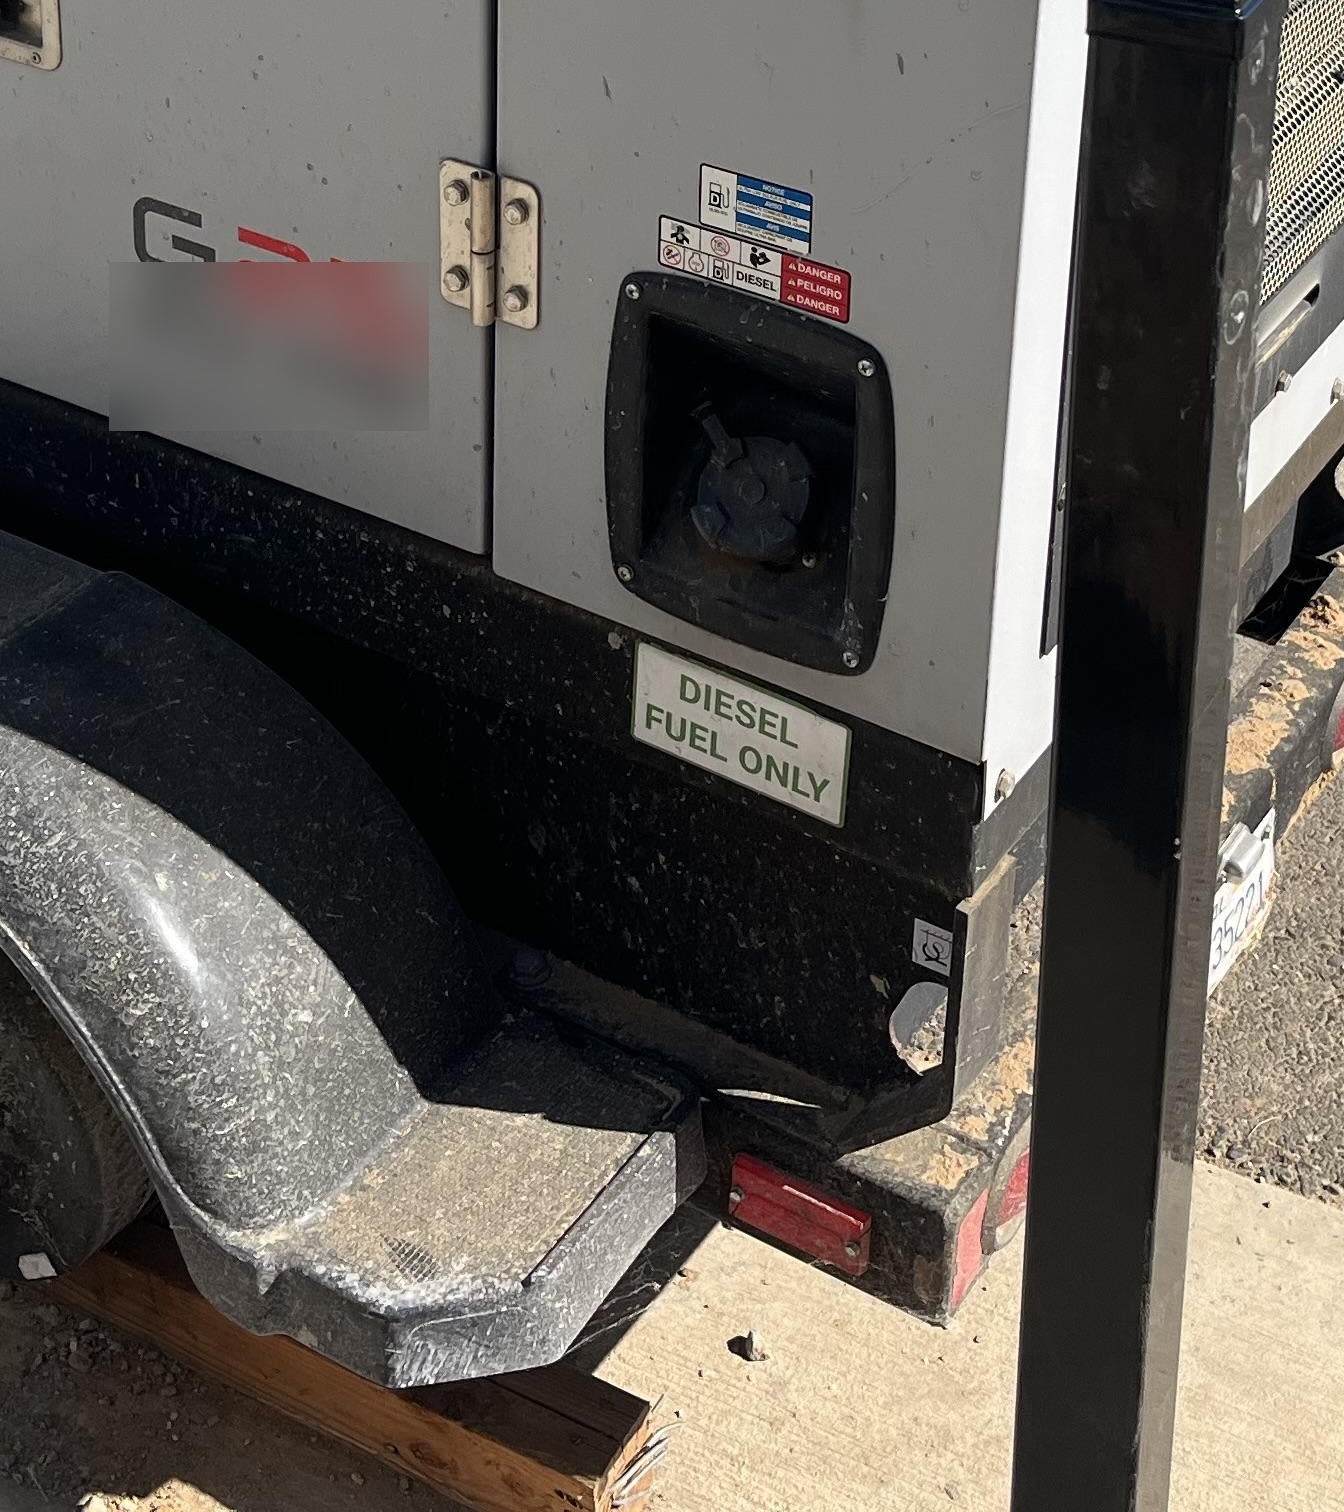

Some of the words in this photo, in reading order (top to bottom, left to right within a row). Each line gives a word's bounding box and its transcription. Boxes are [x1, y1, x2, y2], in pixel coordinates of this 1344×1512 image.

[736, 271, 777, 292] DIESEL
[798, 263, 842, 284] DANGER
[797, 279, 843, 300] PELIGRO
[797, 294, 841, 315] DANGER
[679, 673, 799, 749] DIESEL
[645, 702, 728, 763] FUEL
[738, 745, 831, 803] ONLY
